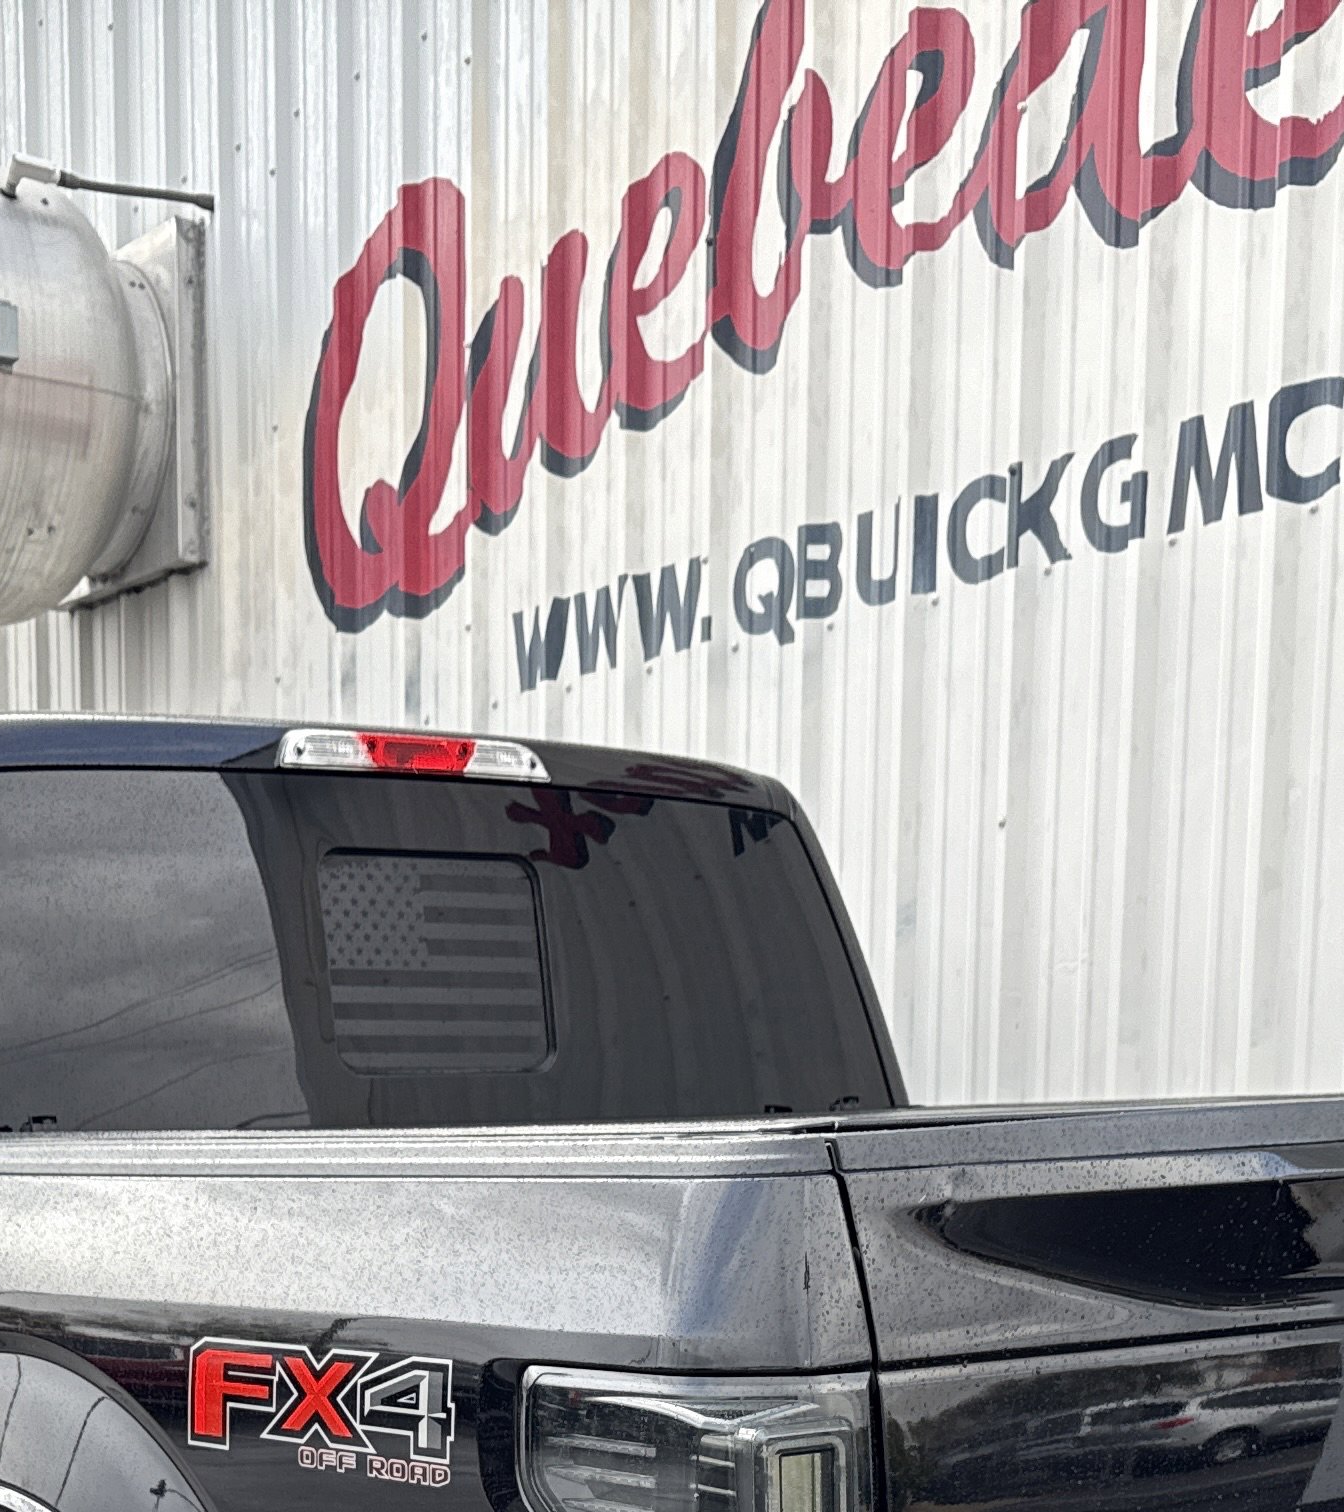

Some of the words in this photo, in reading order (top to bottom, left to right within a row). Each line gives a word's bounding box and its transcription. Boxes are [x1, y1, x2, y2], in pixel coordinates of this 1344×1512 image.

[188, 1336, 456, 1465] FX4
[298, 1446, 357, 1473] OFF
[367, 1455, 451, 1488] ROAD
